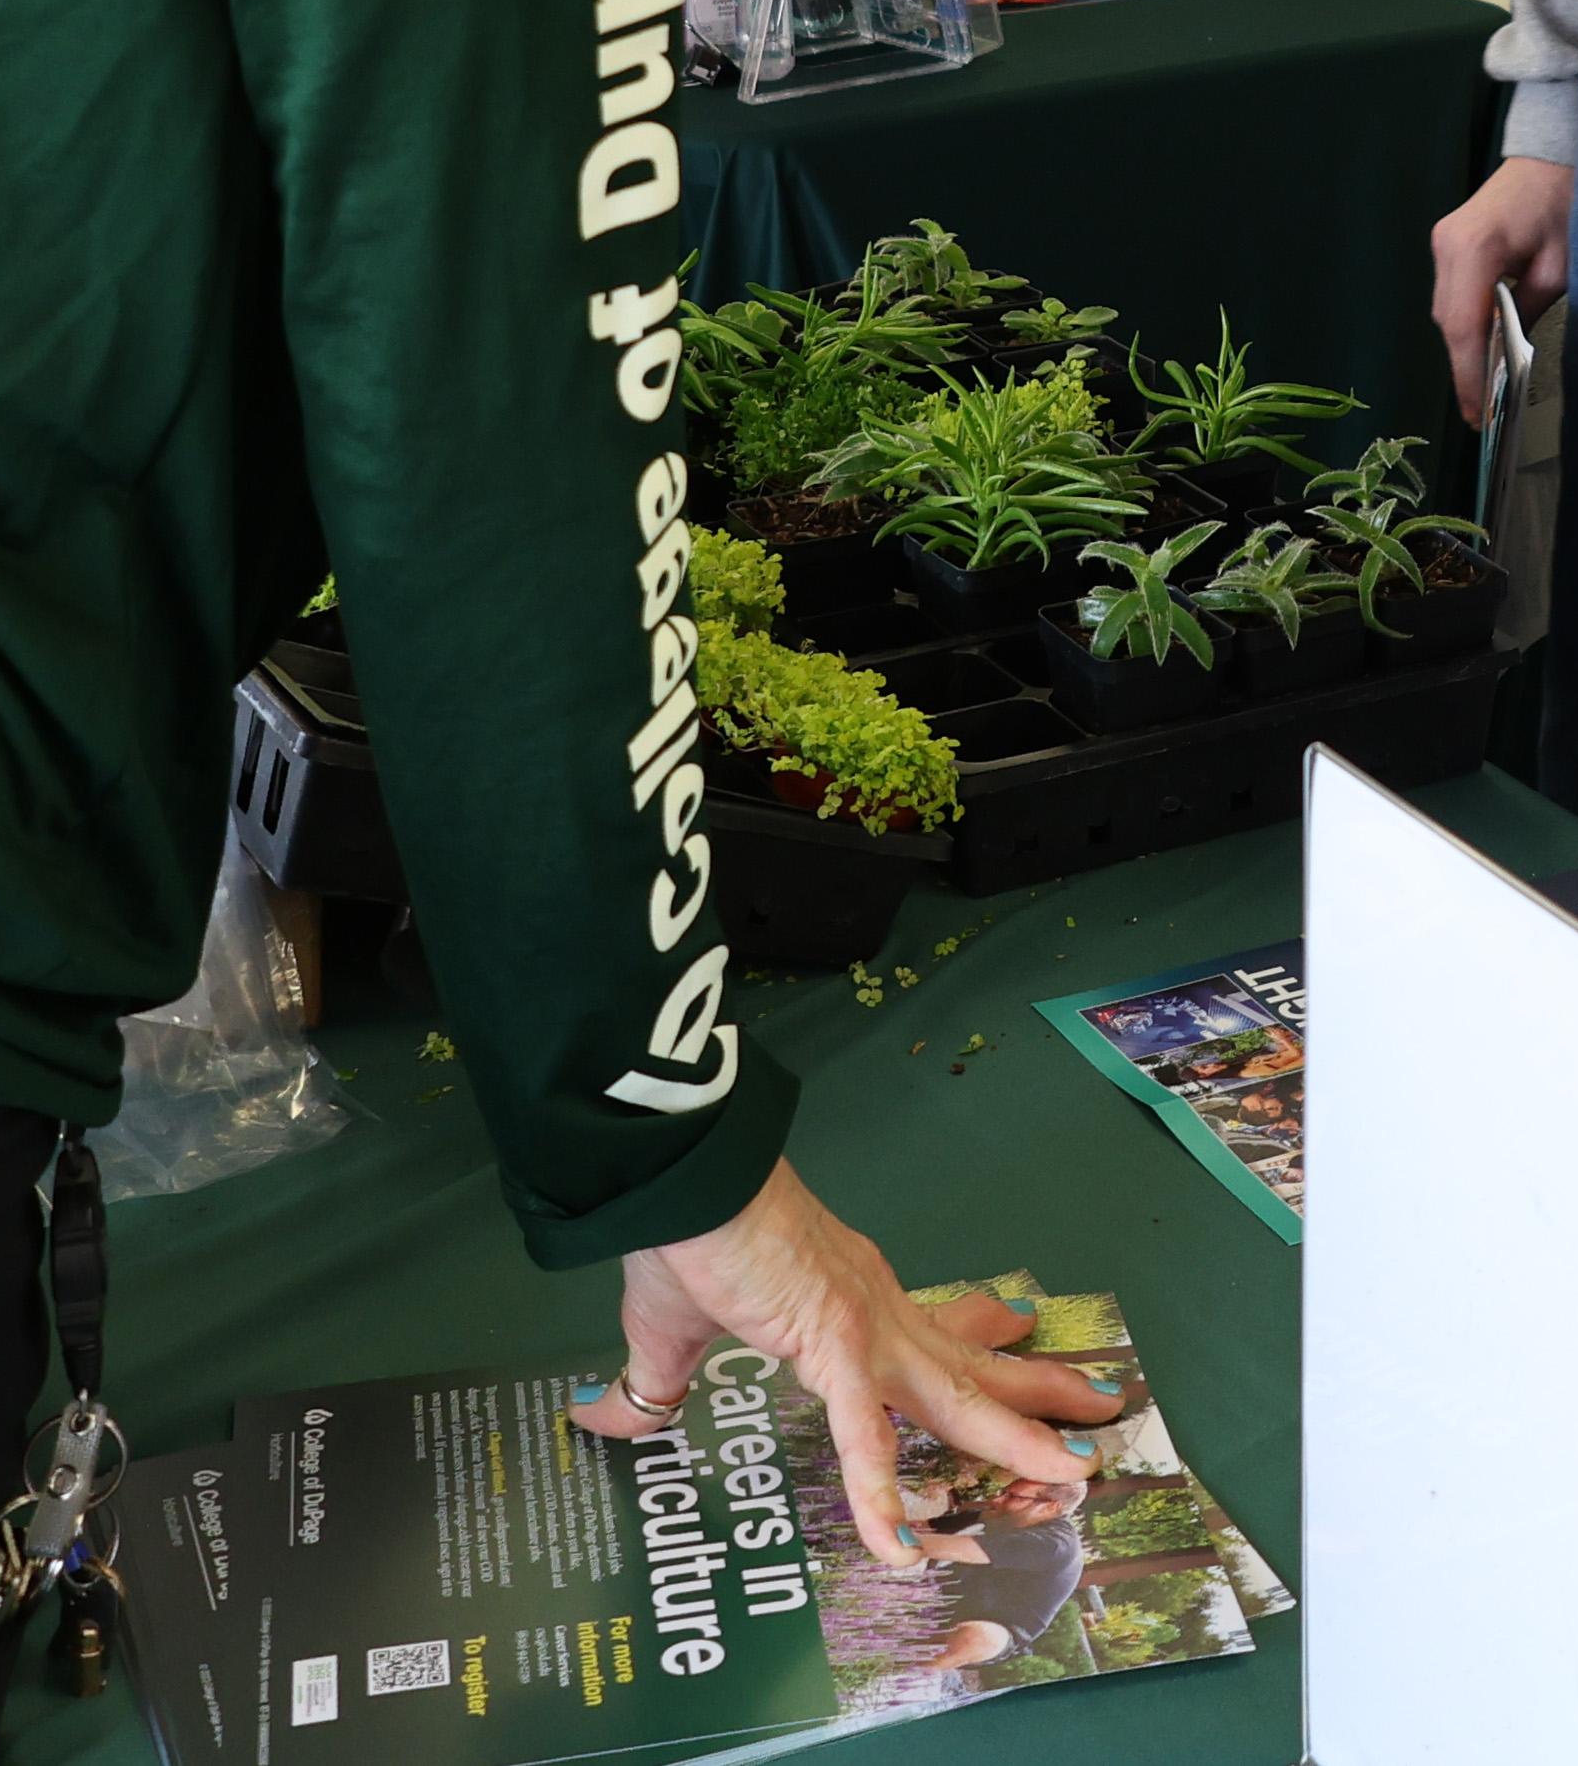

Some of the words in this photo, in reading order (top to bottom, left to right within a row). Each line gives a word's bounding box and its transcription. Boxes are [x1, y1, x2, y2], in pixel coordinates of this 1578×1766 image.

[587, 274, 683, 422] of
[627, 451, 711, 952] College
[269, 1433, 284, 1481] Horticulture
[298, 1428, 325, 1475] College
[704, 1347, 794, 1551] Careers
[303, 1476, 325, 1491] of
[162, 1497, 183, 1548] Horticulture
[196, 1488, 223, 1539] College
[297, 1491, 325, 1545] DuPage
[632, 1384, 728, 1675] rticulture
[741, 1560, 822, 1616] in
[463, 1634, 486, 1655] To
[553, 1624, 569, 1652] Career
[608, 1615, 633, 1642] For
[460, 1655, 489, 1717] register
[556, 1651, 573, 1687] Services
[576, 1620, 606, 1706] information
[611, 1643, 634, 1684] more
